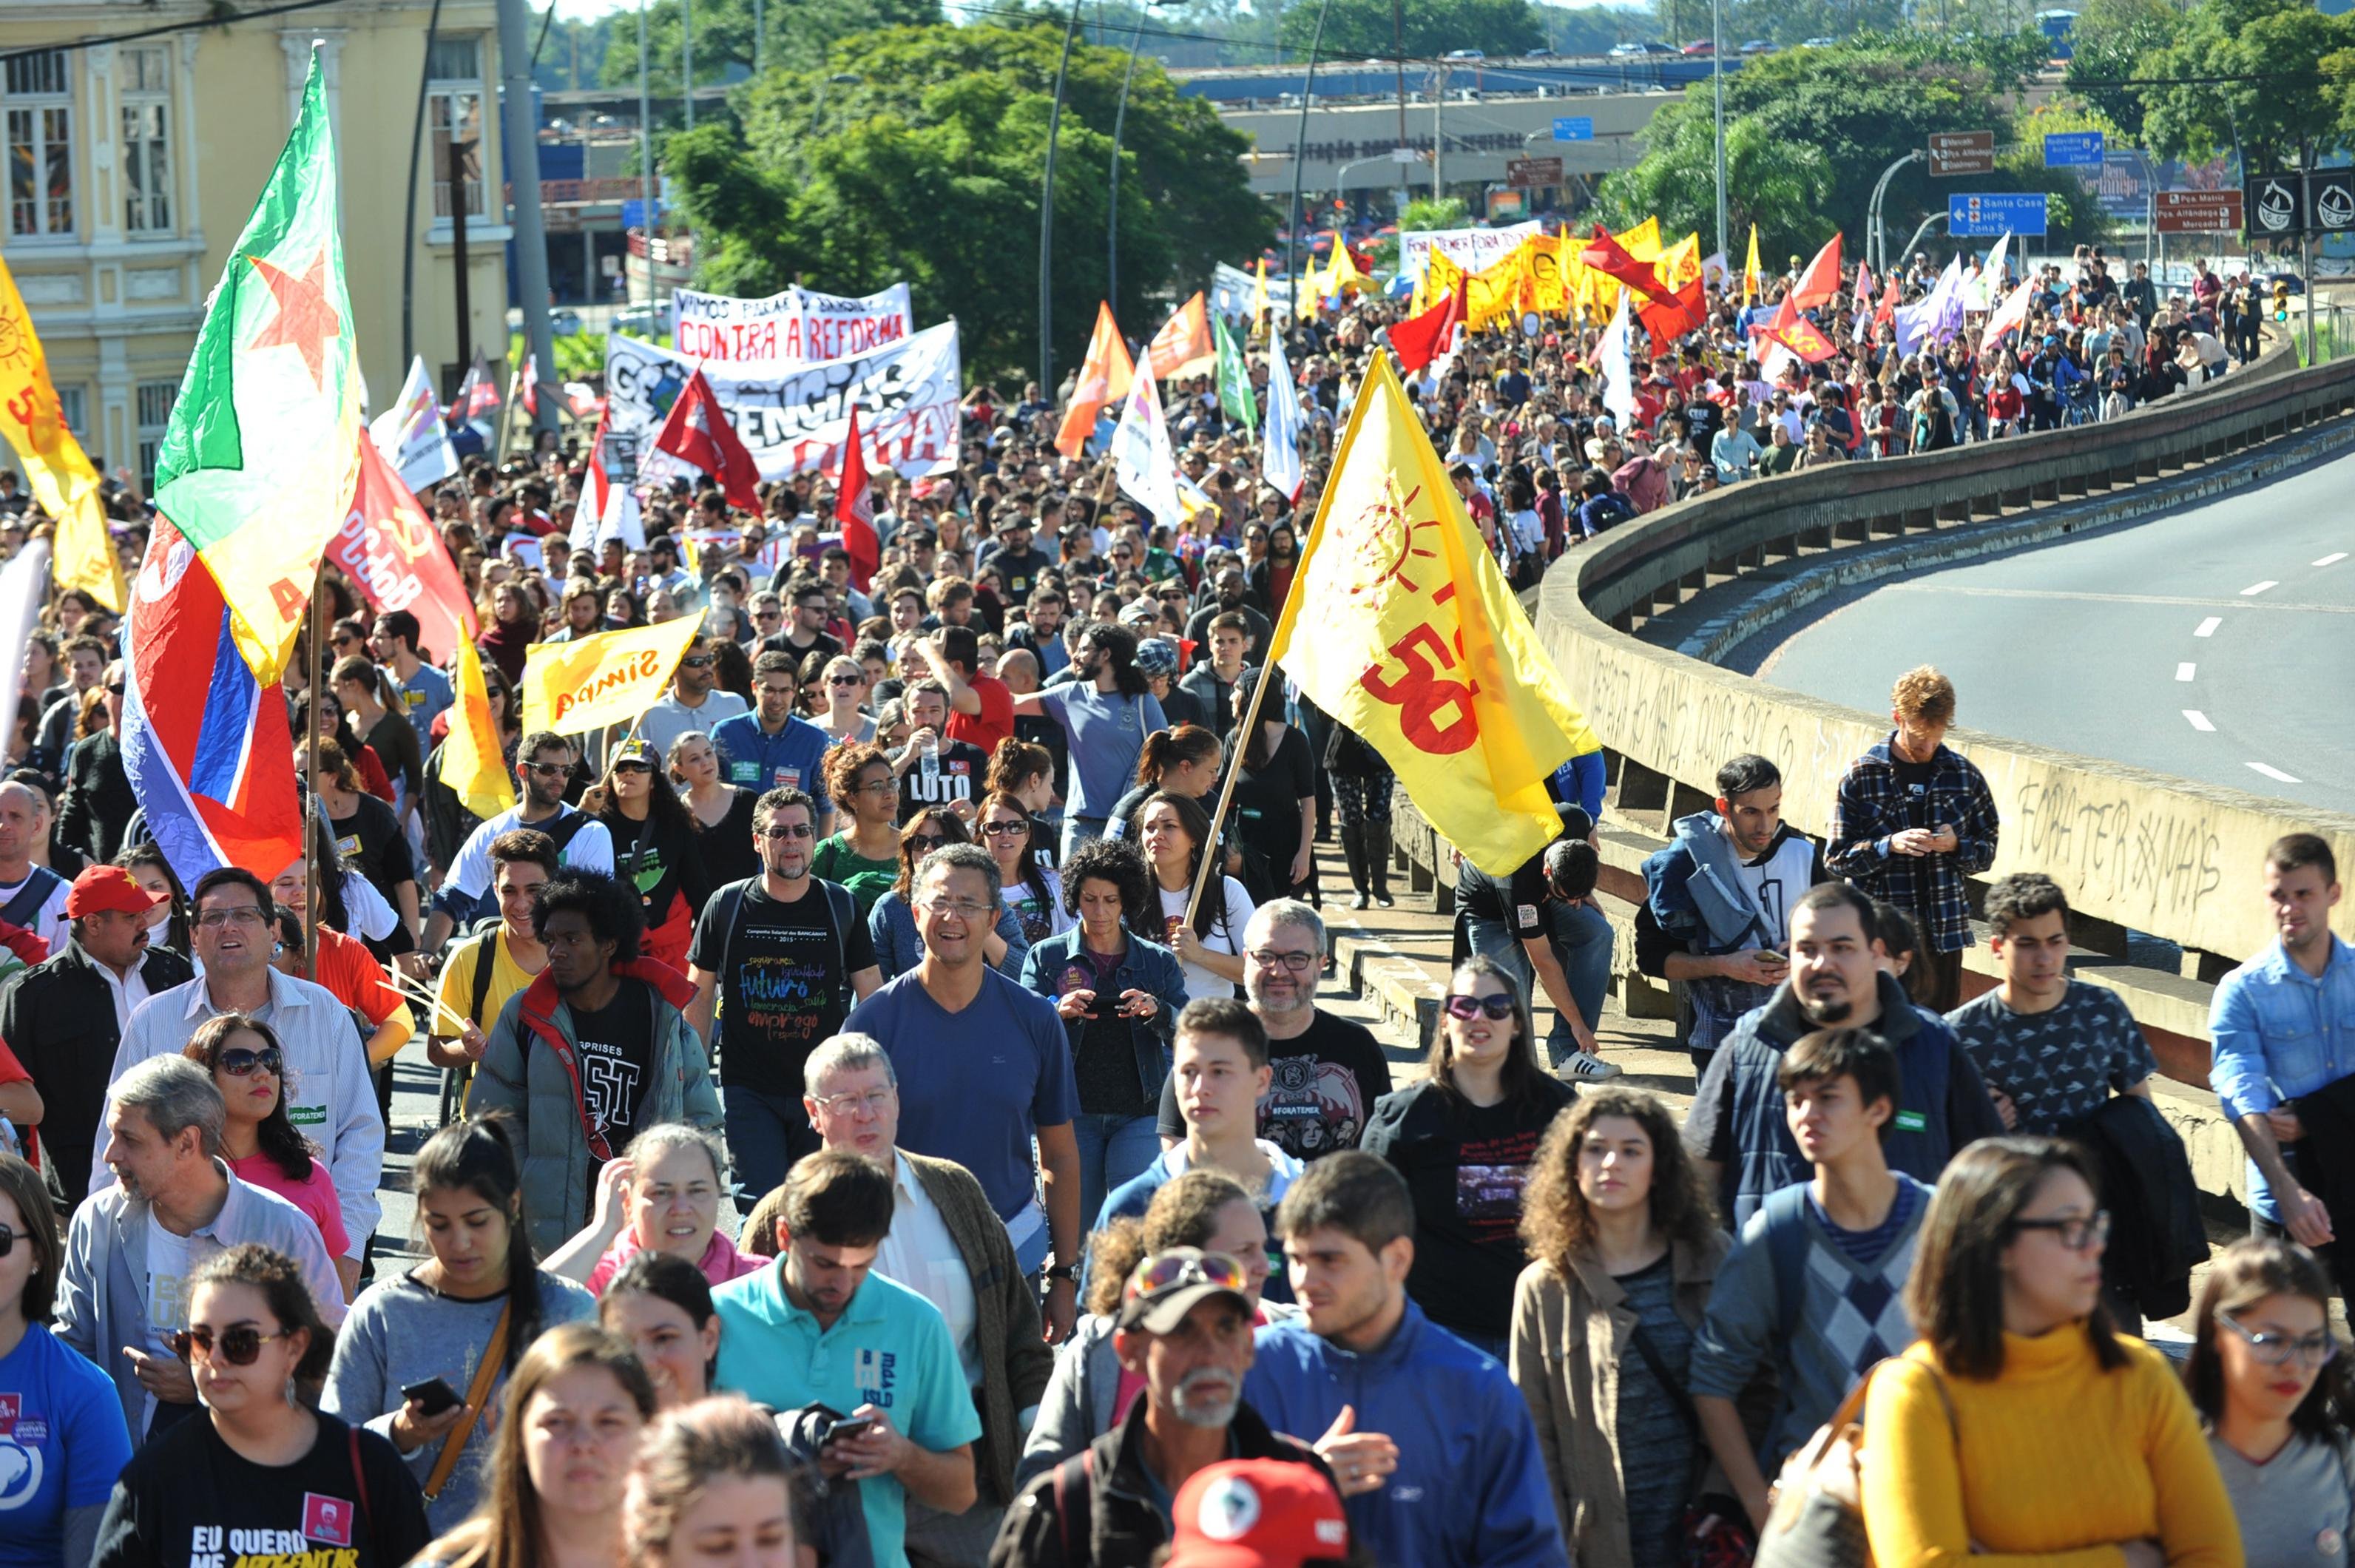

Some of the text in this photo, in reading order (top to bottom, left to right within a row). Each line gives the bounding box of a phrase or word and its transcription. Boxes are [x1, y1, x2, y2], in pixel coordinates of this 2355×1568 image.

[1983, 197, 2042, 208] Santa Casa
[1983, 212, 2005, 222] HPS
[1968, 223, 1996, 234] Zona
[678, 313, 903, 361] CONTRA A REFORMA
[910, 772, 970, 802] LUTO
[739, 964, 808, 1008] futuro
[192, 1525, 223, 1553] EU
[229, 1528, 308, 1556] QUERO
